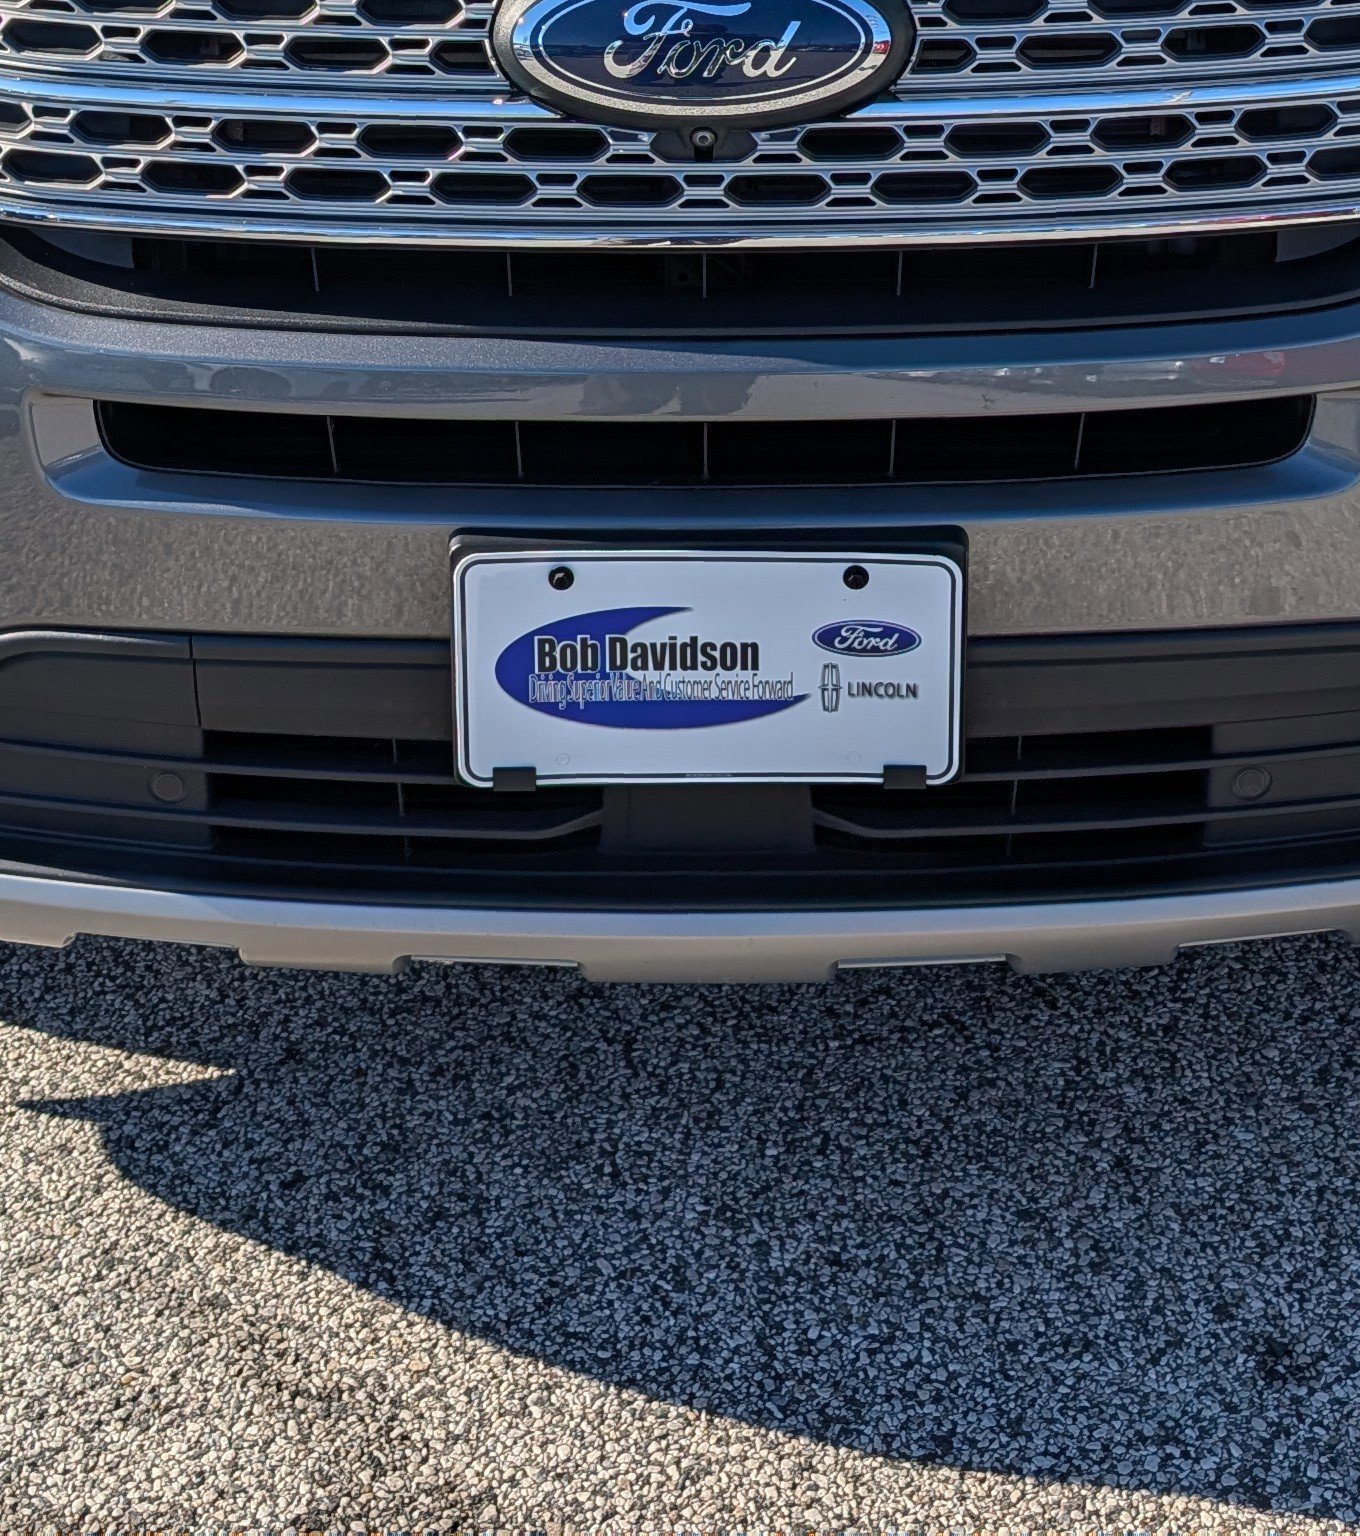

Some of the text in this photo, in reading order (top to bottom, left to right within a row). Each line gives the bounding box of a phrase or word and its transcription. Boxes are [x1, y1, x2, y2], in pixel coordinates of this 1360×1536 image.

[535, 635, 760, 673] Bob Davidson
[834, 625, 900, 651] Ford
[529, 673, 566, 710] Driving
[567, 672, 610, 710] Superior
[611, 672, 642, 702] Value
[664, 672, 713, 702] Customer
[714, 672, 750, 702] Service
[752, 671, 794, 702] Forward
[847, 681, 919, 699] LINCOLN
